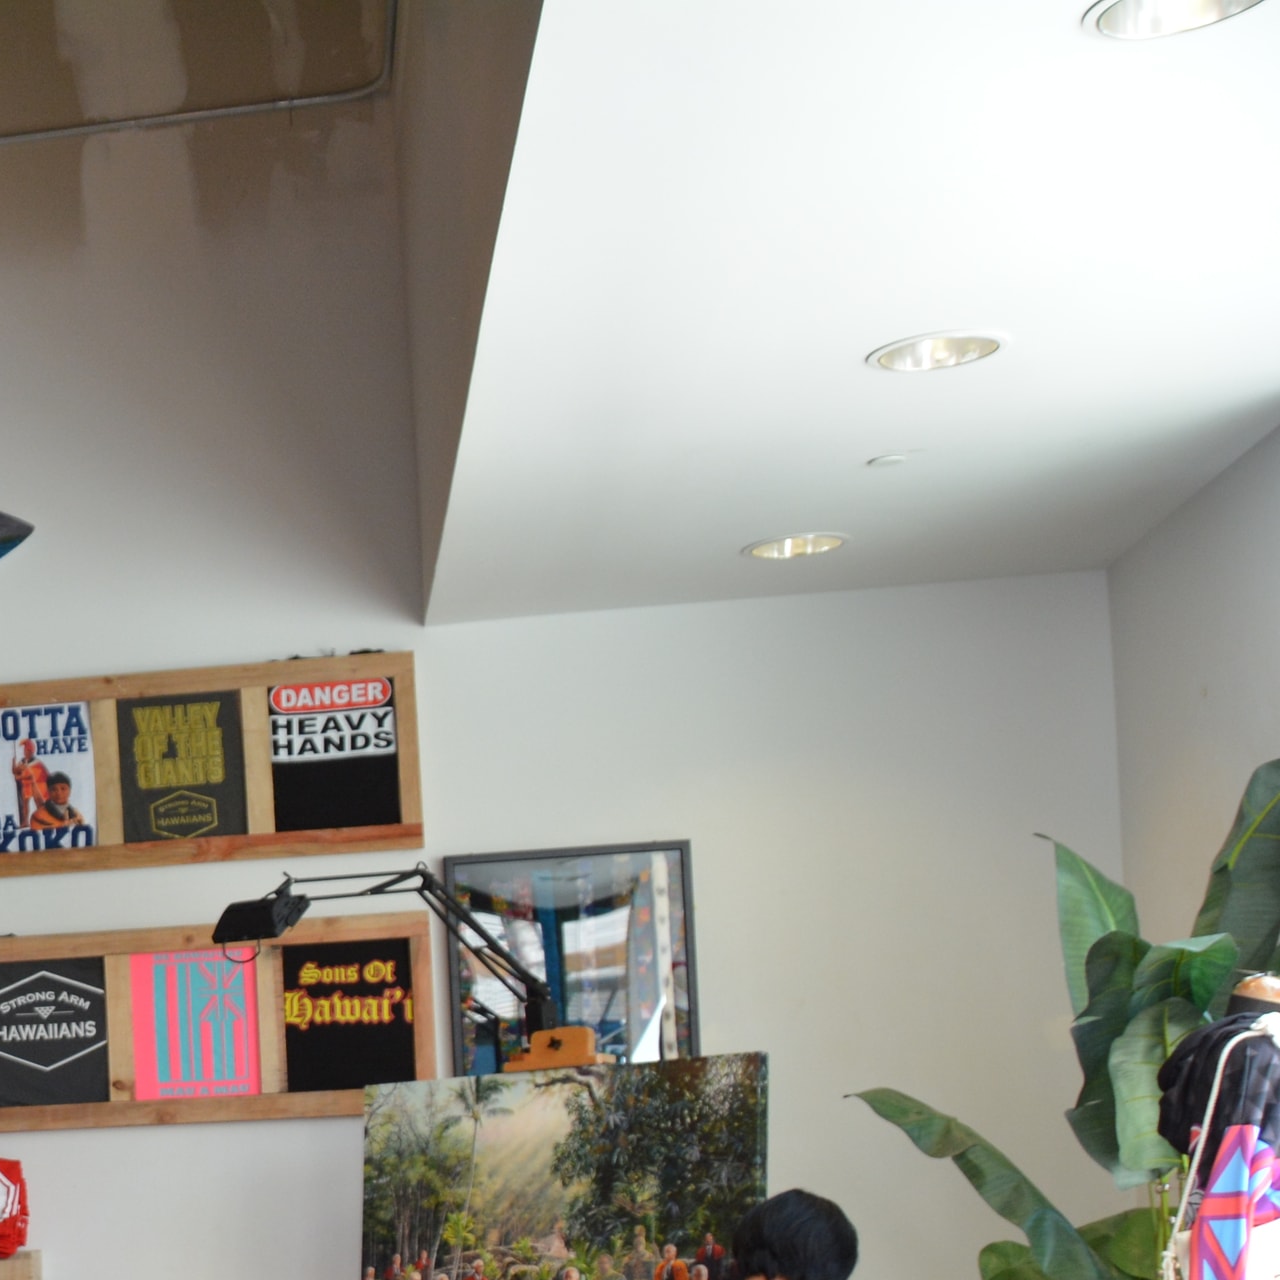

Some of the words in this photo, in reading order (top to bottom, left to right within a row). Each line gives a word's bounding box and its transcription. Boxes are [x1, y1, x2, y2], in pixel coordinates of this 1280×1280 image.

[280, 682, 384, 708] DANGER
[132, 701, 221, 733] VALLEY
[271, 709, 392, 737] HEAVY
[35, 736, 89, 756] HAVE
[133, 734, 167, 761] OF
[177, 728, 223, 759] THE
[272, 731, 394, 757] HANDS
[137, 758, 225, 788] GIANTS
[156, 813, 213, 827] HAWAIIANS
[298, 960, 359, 985] Sons
[362, 959, 396, 984] Of
[59, 991, 92, 1010] ARM
